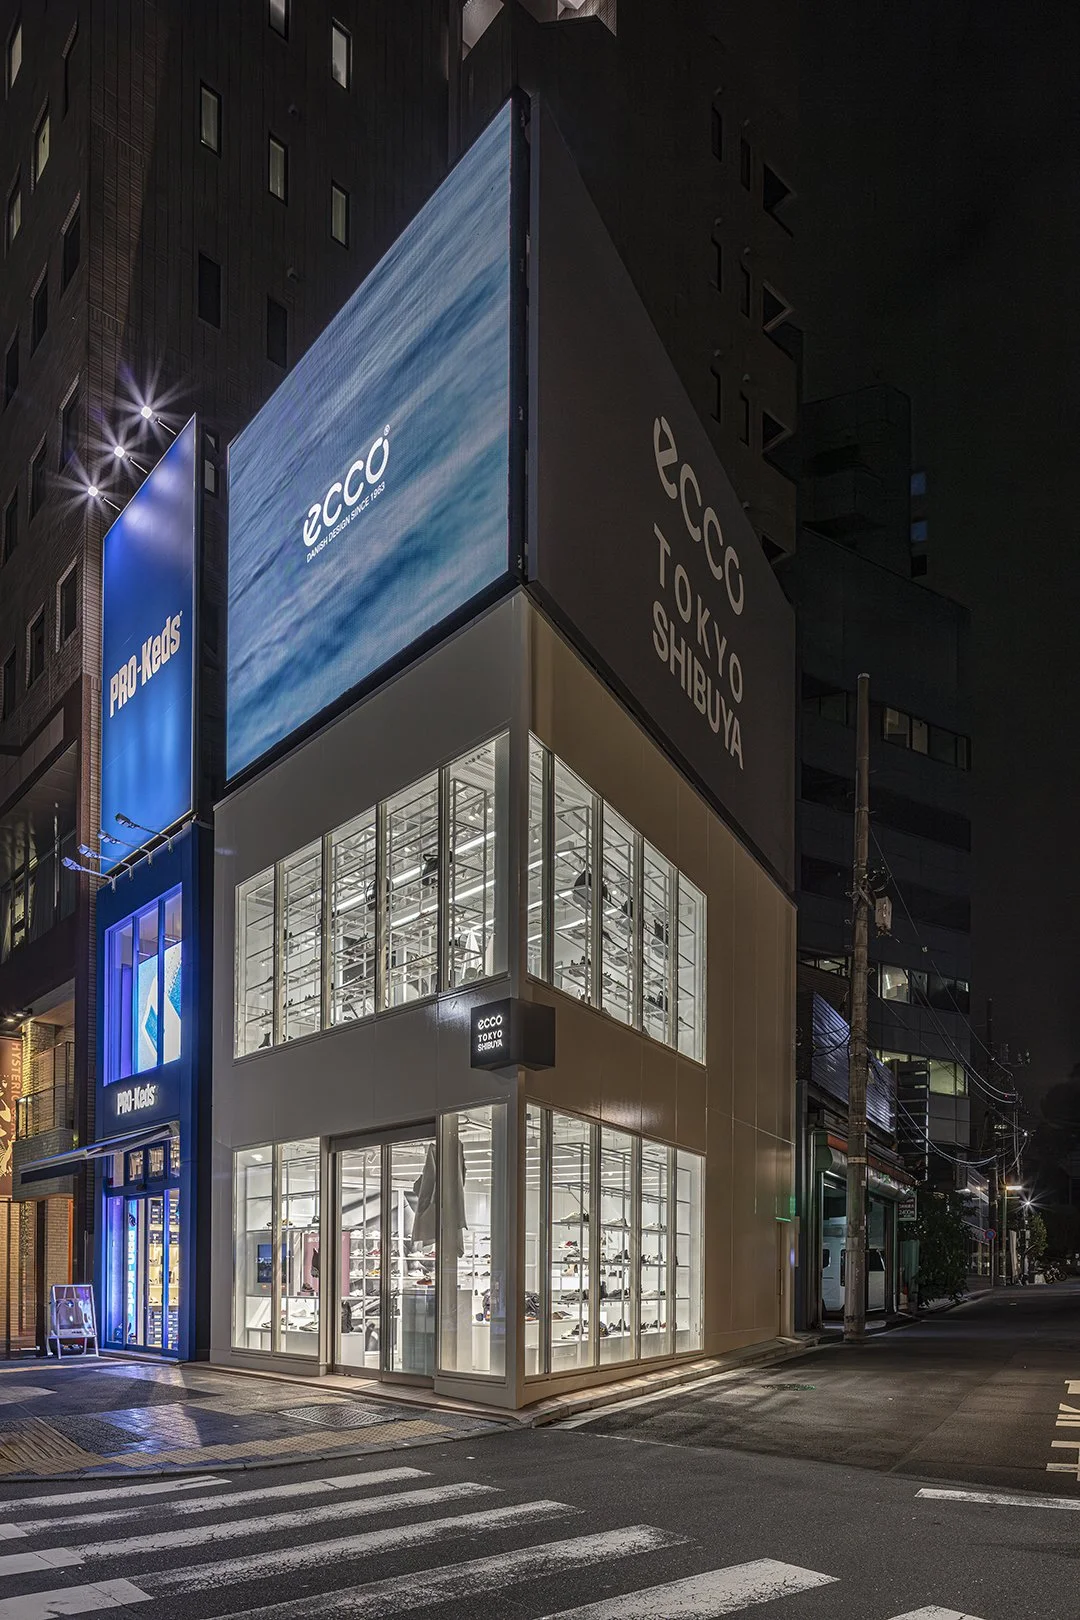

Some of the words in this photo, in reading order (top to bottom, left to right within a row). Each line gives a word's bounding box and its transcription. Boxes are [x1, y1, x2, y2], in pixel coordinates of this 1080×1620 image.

[303, 436, 389, 547] ecco
[306, 537, 329, 563] DANISH
[328, 515, 351, 542] DESIGN
[350, 496, 370, 520] SINCE
[370, 481, 386, 501] 1963
[654, 416, 744, 616] ecco
[653, 523, 743, 704] TOKYO
[110, 613, 181, 718] PRO-Keds
[653, 601, 744, 770] SHIBUYA
[477, 1029, 503, 1043] TOKYO
[477, 1039, 503, 1052] SHIBUYA
[478, 1014, 503, 1030] ecco
[117, 1084, 156, 1116] PRO-Keds
